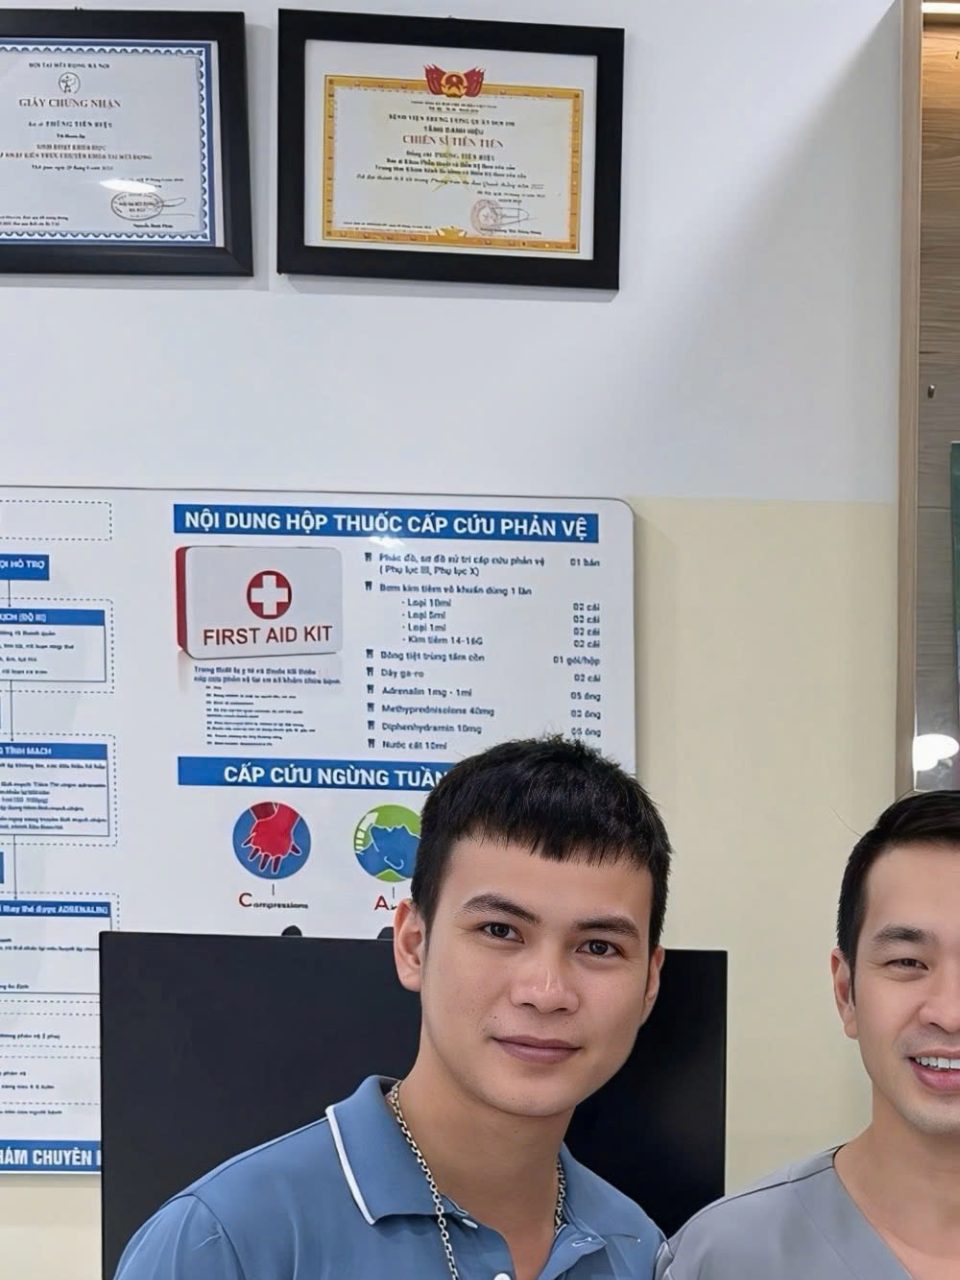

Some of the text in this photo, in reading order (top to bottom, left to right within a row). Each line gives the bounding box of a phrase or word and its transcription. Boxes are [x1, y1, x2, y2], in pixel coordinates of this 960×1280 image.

[185, 508, 587, 541] NỘI DUNG HỘP THUỐC CẤP CỨU PHẢN VỆ
[203, 625, 333, 646] FIRST AID KIT
[224, 762, 265, 784] CẤP
[270, 764, 312, 785] CỨU
[317, 765, 390, 787] NGỪNG
[32, 1147, 93, 1166] CHUYÊN
